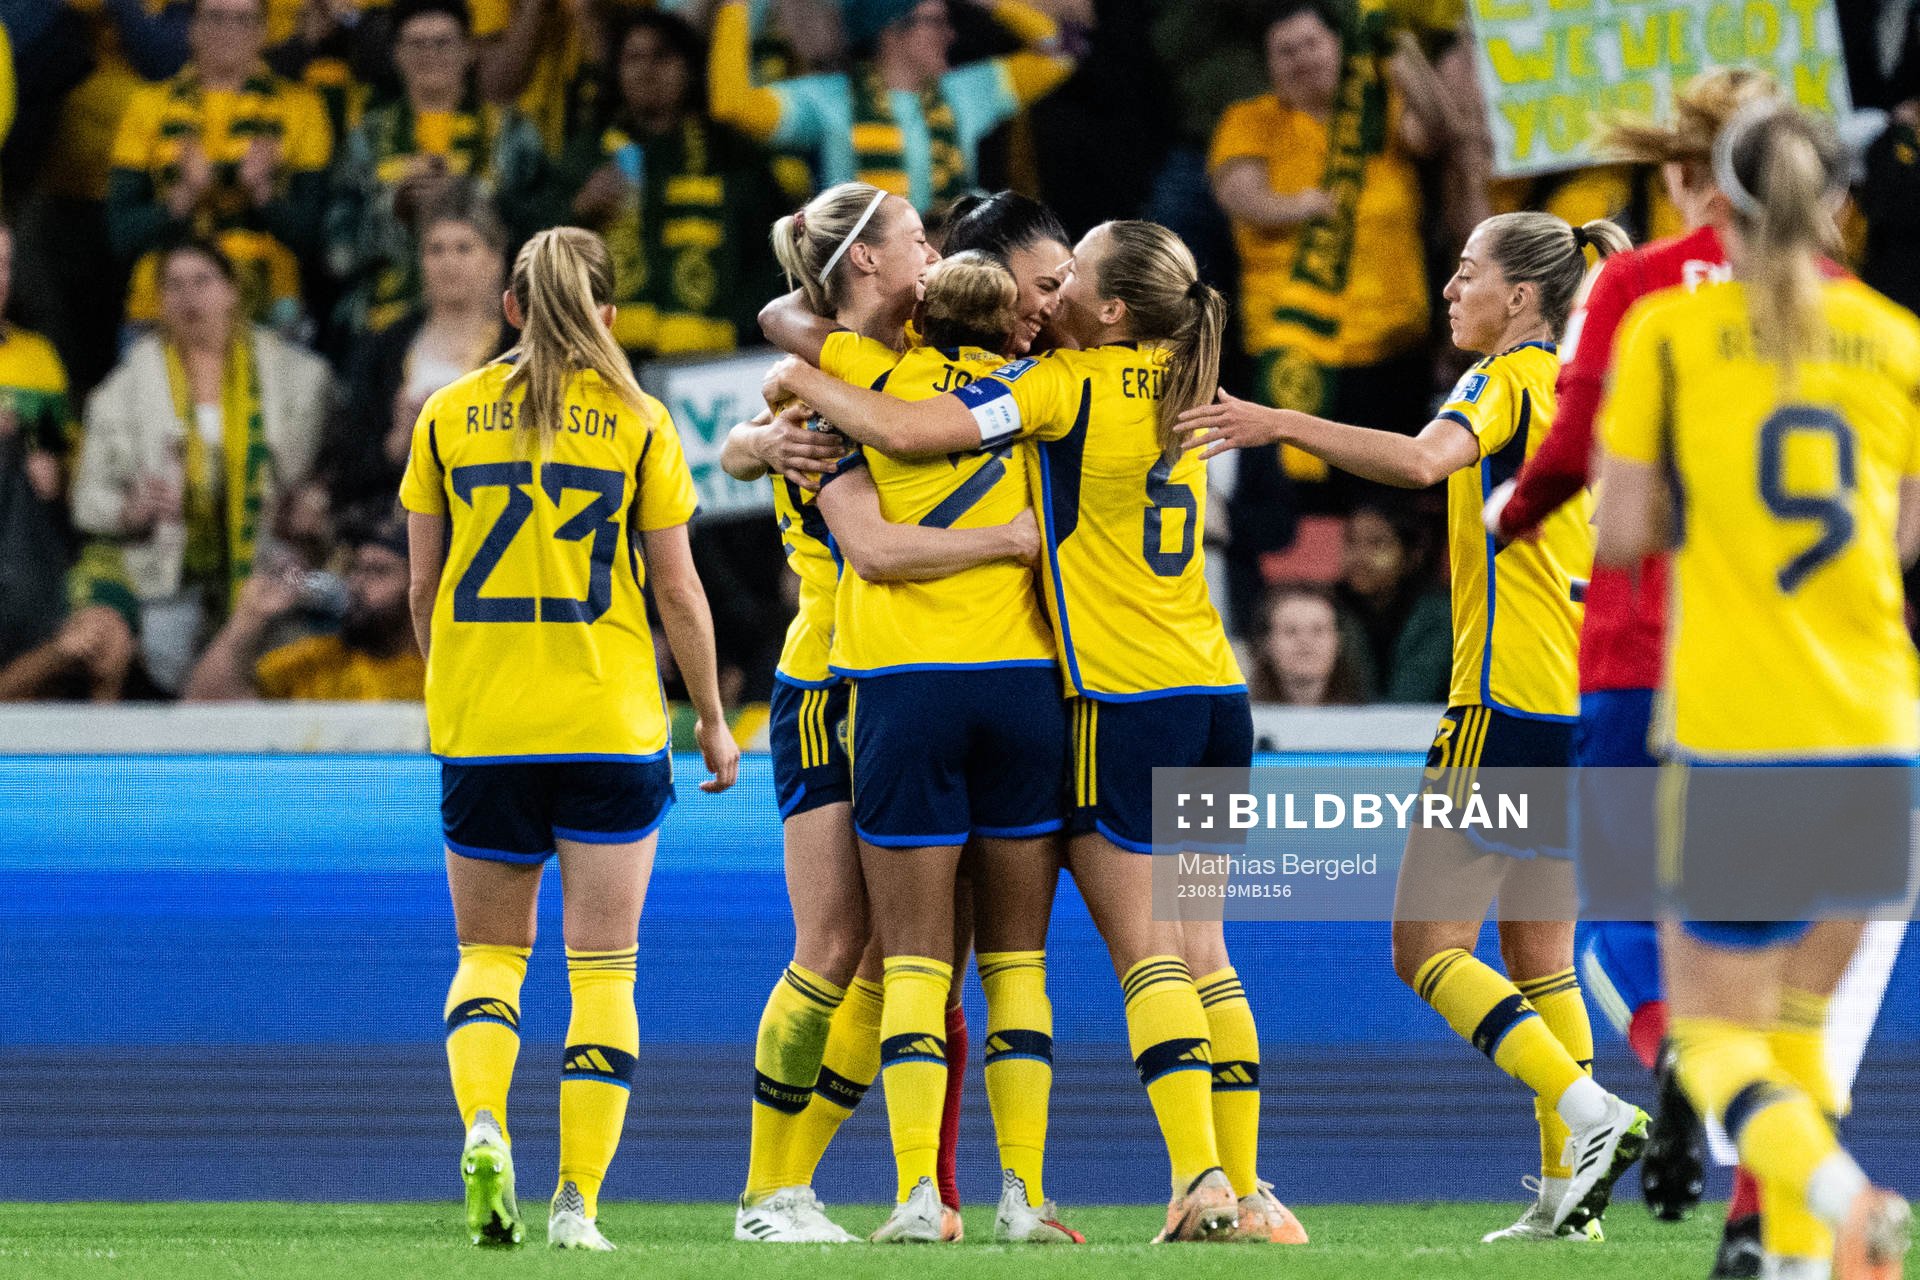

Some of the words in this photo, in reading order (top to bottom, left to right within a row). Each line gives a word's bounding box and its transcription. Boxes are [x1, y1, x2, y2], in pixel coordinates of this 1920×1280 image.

[466, 402, 617, 441] RUBSON
[452, 461, 626, 623] 23
[1143, 450, 1196, 577] 6
[1757, 405, 1855, 592] 9
